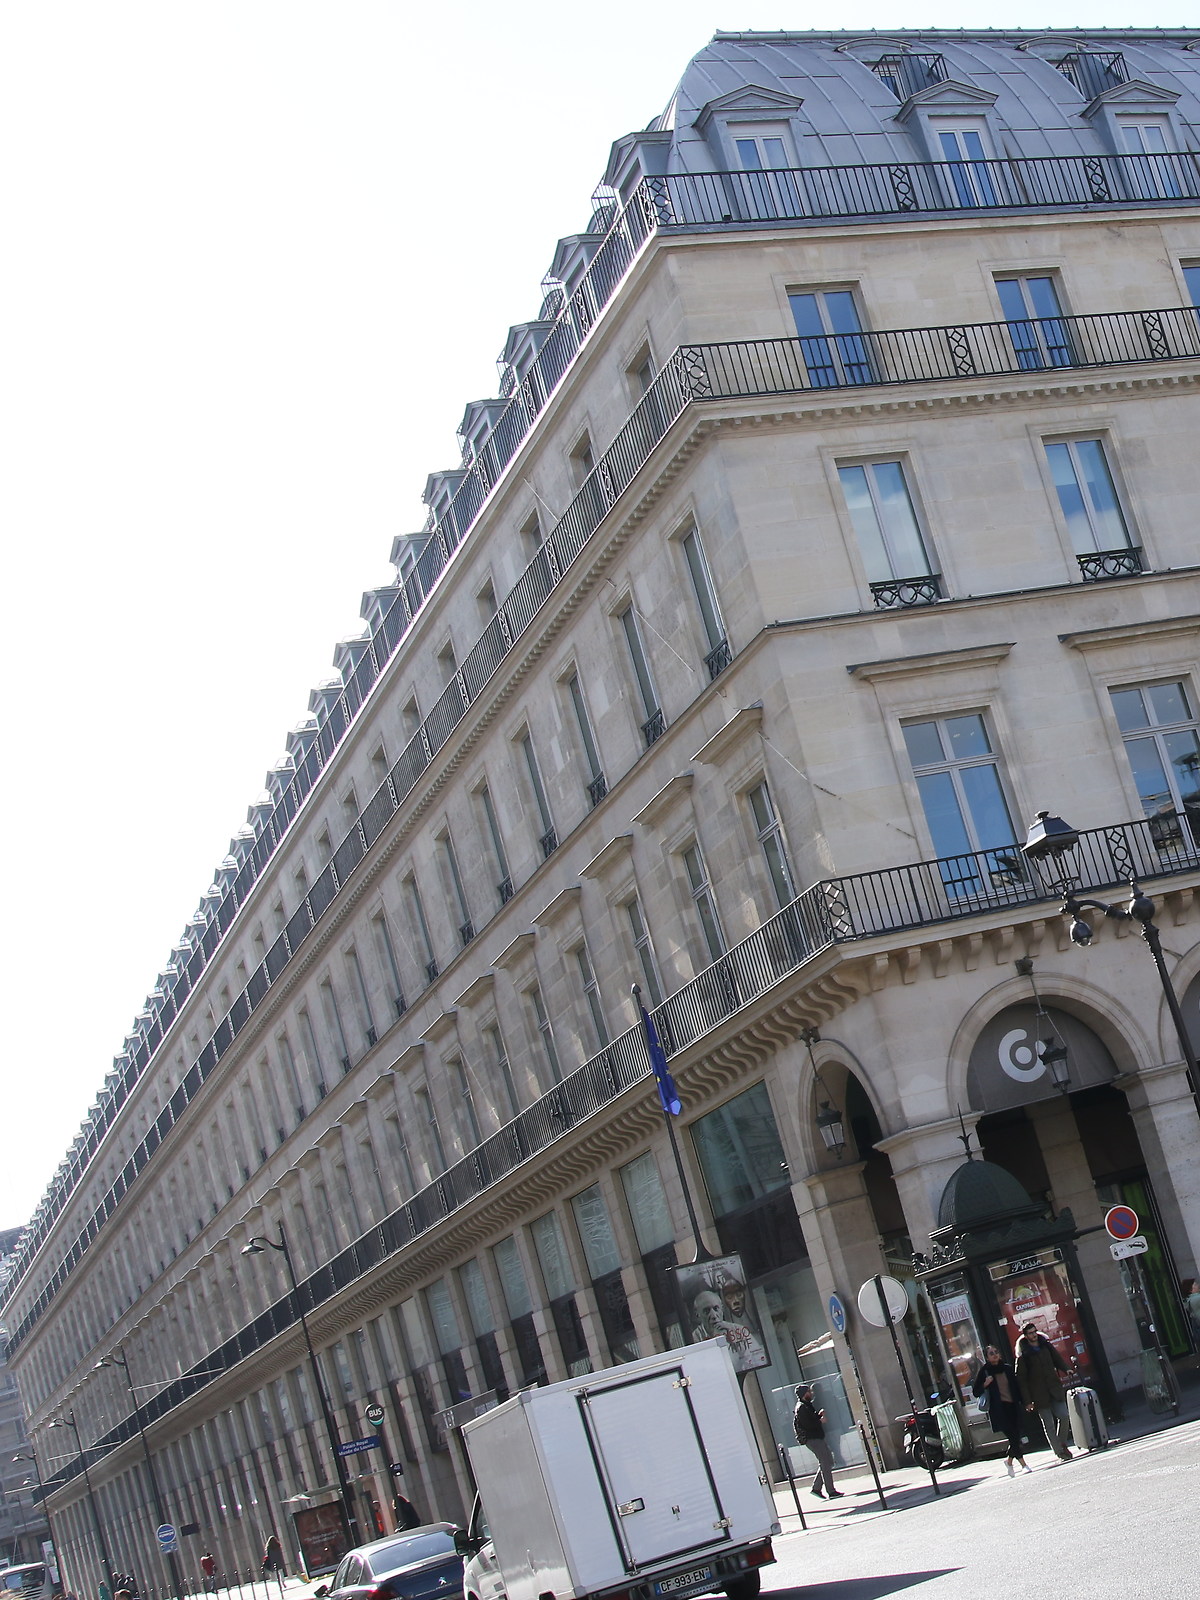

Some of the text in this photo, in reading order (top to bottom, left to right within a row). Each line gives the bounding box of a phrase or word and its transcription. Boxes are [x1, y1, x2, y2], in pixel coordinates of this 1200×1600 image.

[1011, 1259, 1042, 1272] Presse
[368, 1407, 383, 1418] BUS
[342, 1439, 369, 1450] Palais Royal
[360, 1442, 375, 1451] Louvre
[660, 1569, 706, 1592] CF-993-EN
